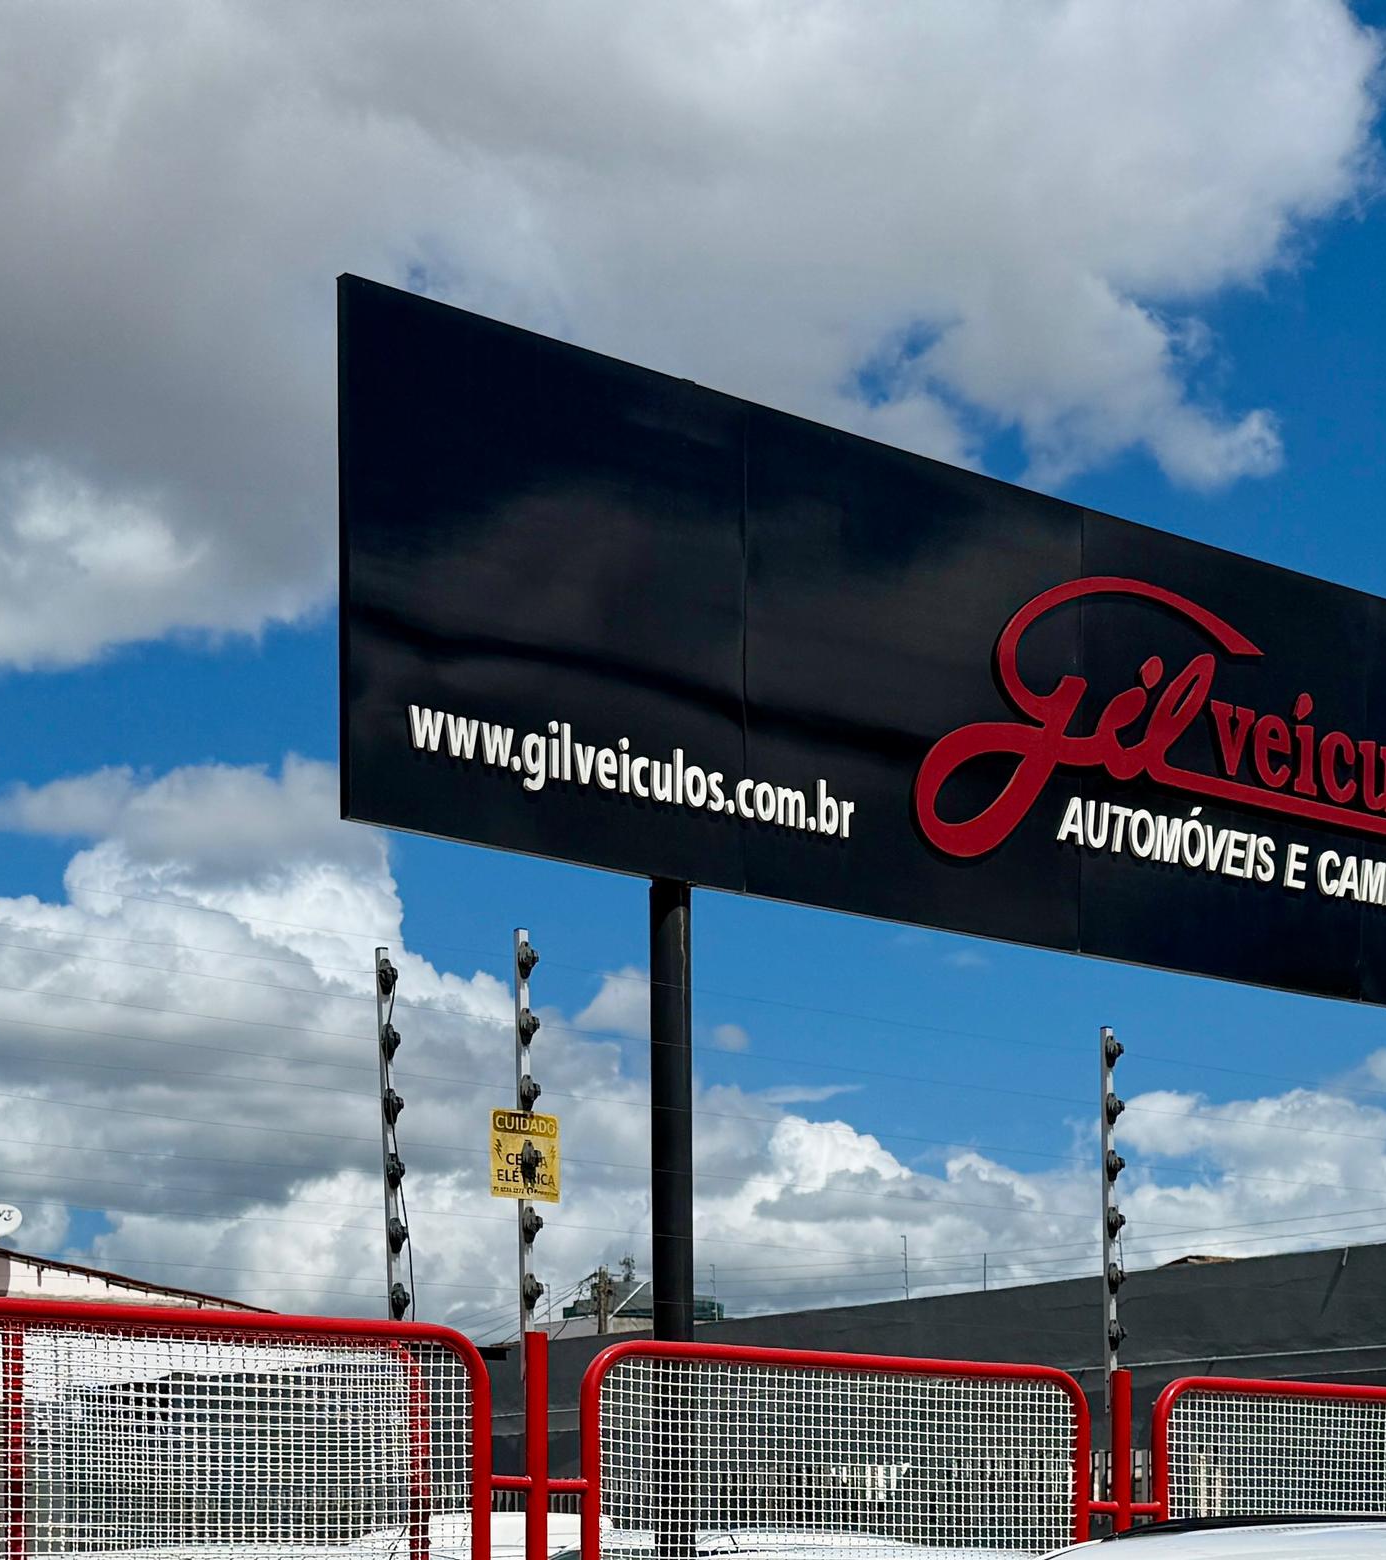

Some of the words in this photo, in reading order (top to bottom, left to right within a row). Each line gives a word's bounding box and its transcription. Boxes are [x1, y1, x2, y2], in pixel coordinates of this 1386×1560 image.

[408, 704, 854, 839] www.gilveiculos.com.br
[1056, 796, 1276, 883] AUTOMÓVEIS
[1283, 842, 1310, 890] E
[495, 1115, 556, 1136] CUIDADO
[506, 1153, 548, 1169] CEA
[497, 1167, 556, 1187] ELÉICA
